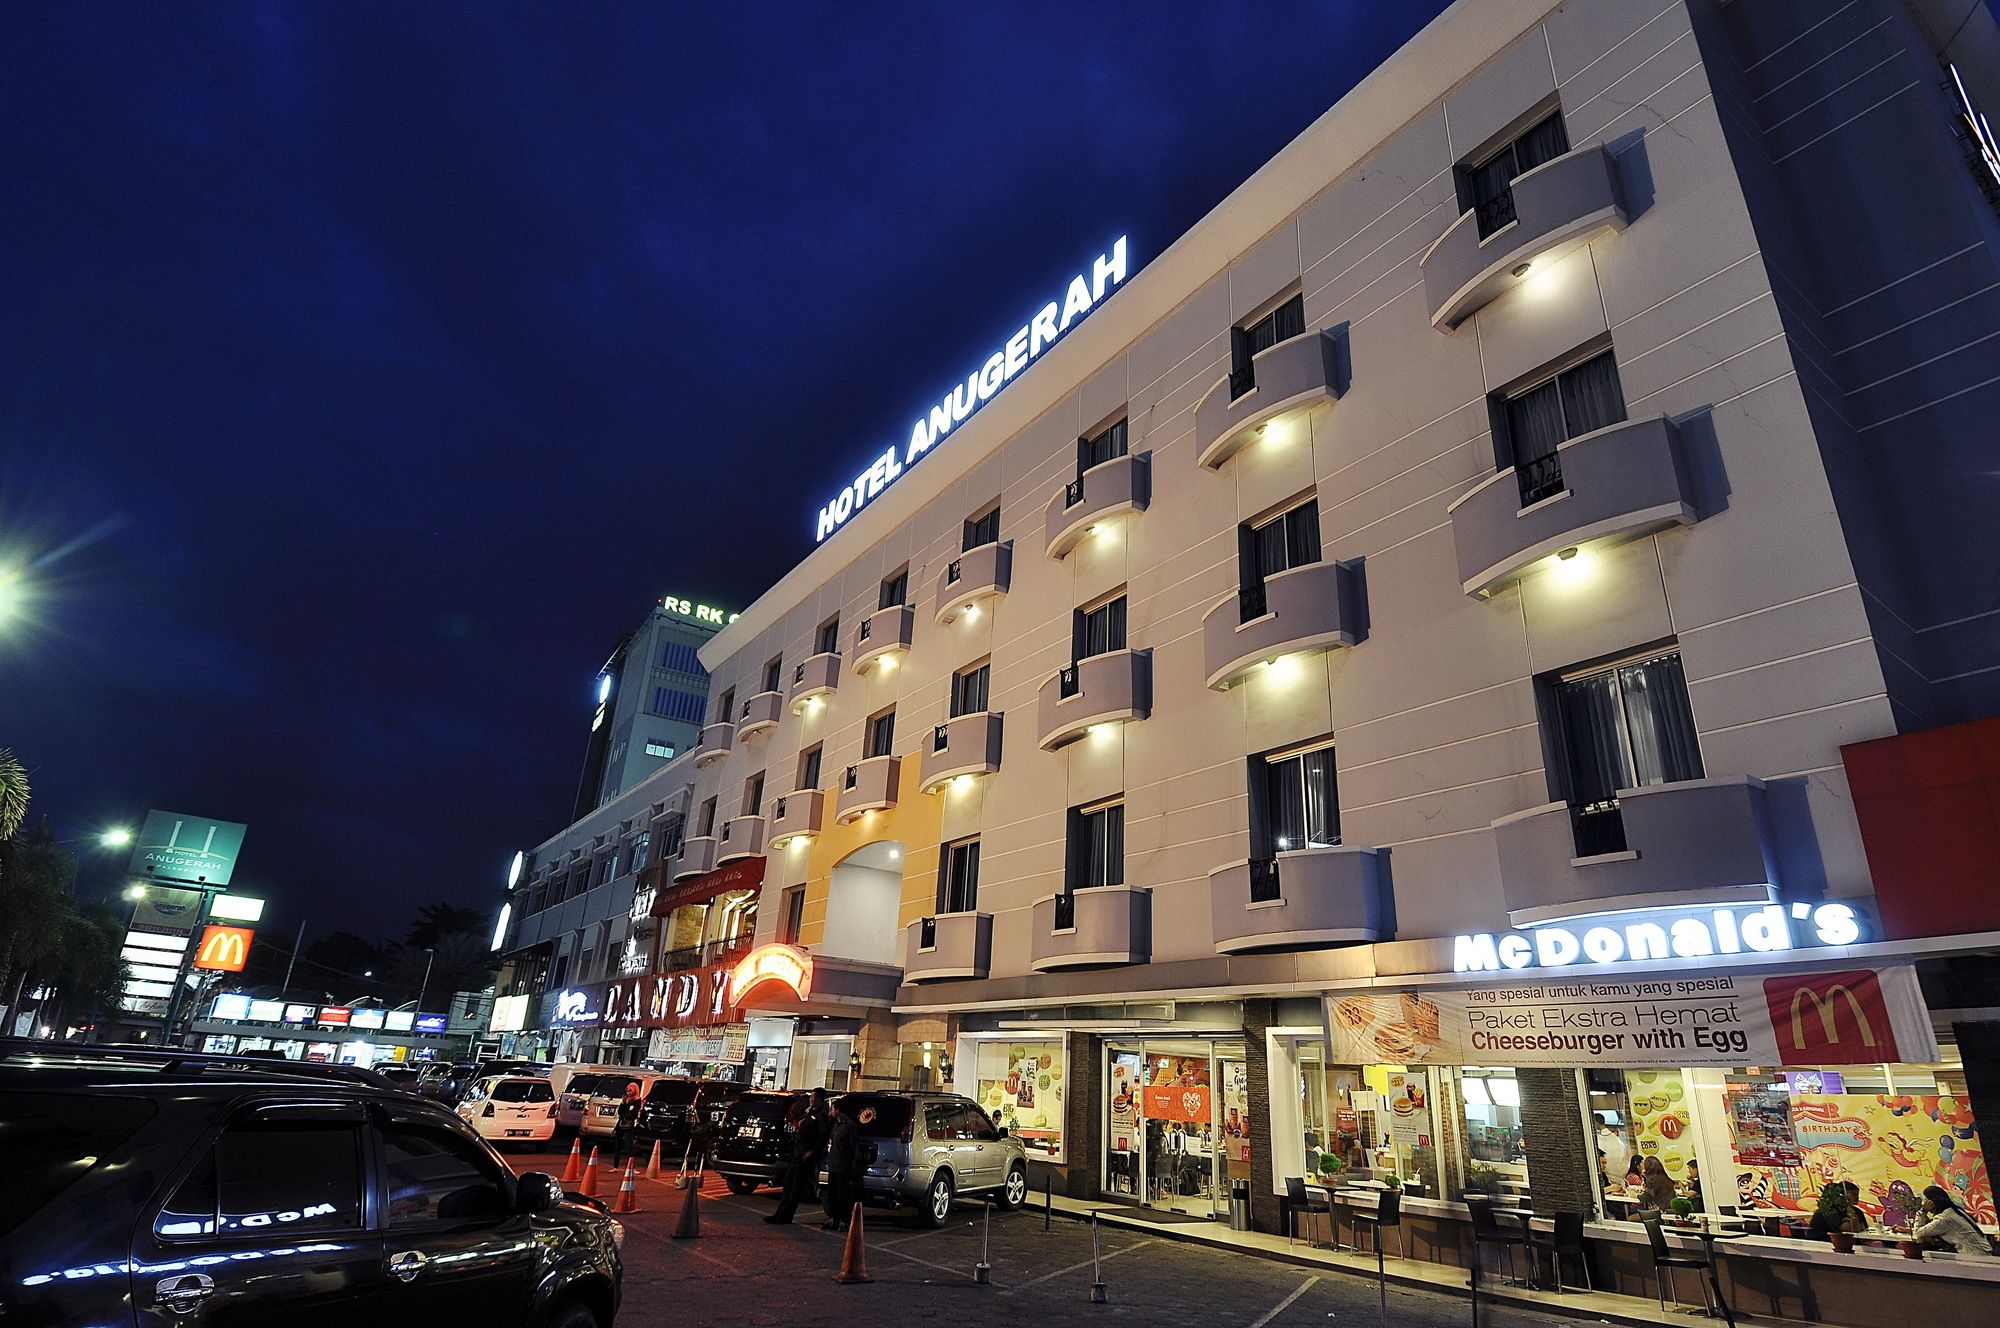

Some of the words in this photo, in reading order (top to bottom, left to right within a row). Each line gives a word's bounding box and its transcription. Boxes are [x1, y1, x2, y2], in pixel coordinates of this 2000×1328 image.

[816, 445, 901, 542] HOTEL
[905, 234, 1127, 465] ANUGERAH
[664, 596, 692, 615] RS
[696, 604, 724, 625] RK
[144, 853, 222, 870] ANUGERAH
[174, 850, 199, 858] HOTEL
[1452, 902, 1860, 972] McDonald's
[604, 970, 731, 1023] CANDY
[1465, 989, 1497, 1003] Yang
[1499, 986, 1544, 1002] spesial
[1548, 984, 1587, 998] untuk
[1591, 982, 1631, 996] kamu
[1635, 981, 1673, 997] yang
[1676, 975, 1734, 995] spesial
[1468, 1009, 1536, 1030] Paket
[1543, 1007, 1628, 1028] Ekstra
[1634, 1002, 1742, 1026] Hemat
[1471, 1030, 1625, 1055] Cheeseburger
[1631, 1028, 1686, 1050] with
[1693, 1025, 1749, 1053] Egg
[1802, 1125, 1851, 1133] BIRTHDAY
